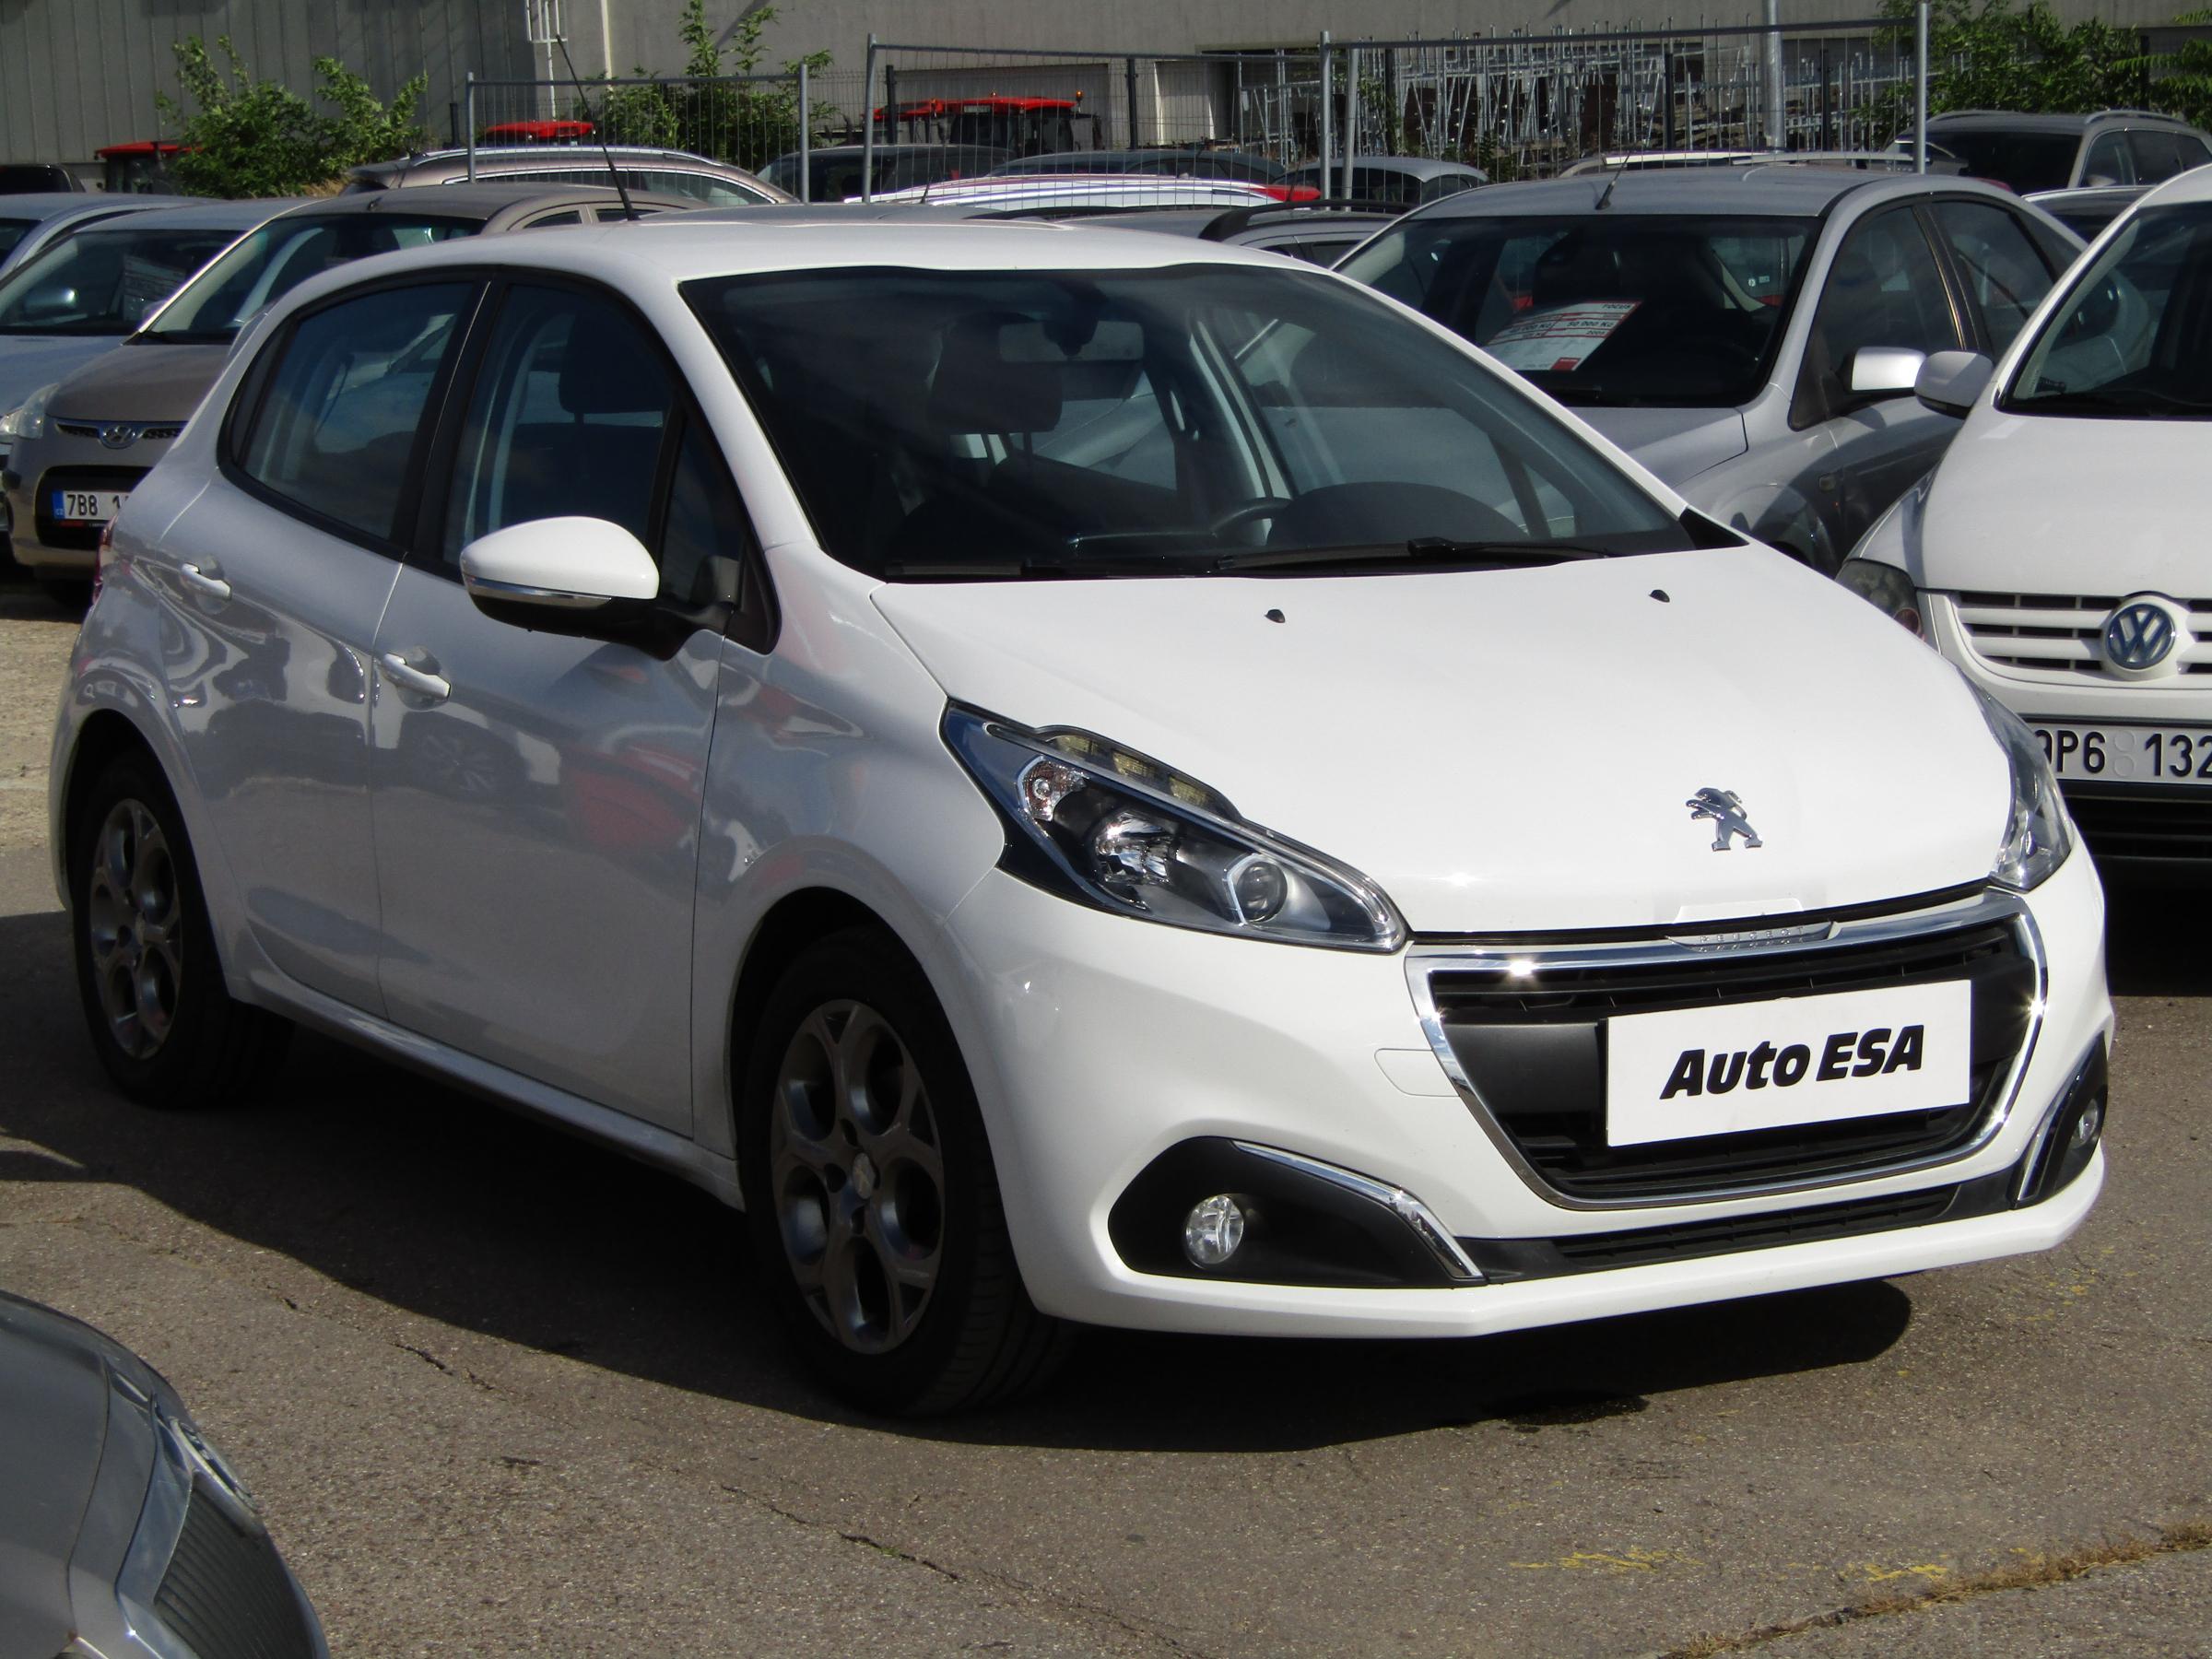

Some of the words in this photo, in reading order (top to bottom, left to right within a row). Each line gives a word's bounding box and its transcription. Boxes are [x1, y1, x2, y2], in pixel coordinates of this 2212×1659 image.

[67, 494, 98, 516] 7B8
[1700, 926, 1804, 943] PEUGEOT
[1659, 1041, 1811, 1100] Auto
[1816, 1024, 1924, 1081] ESA
